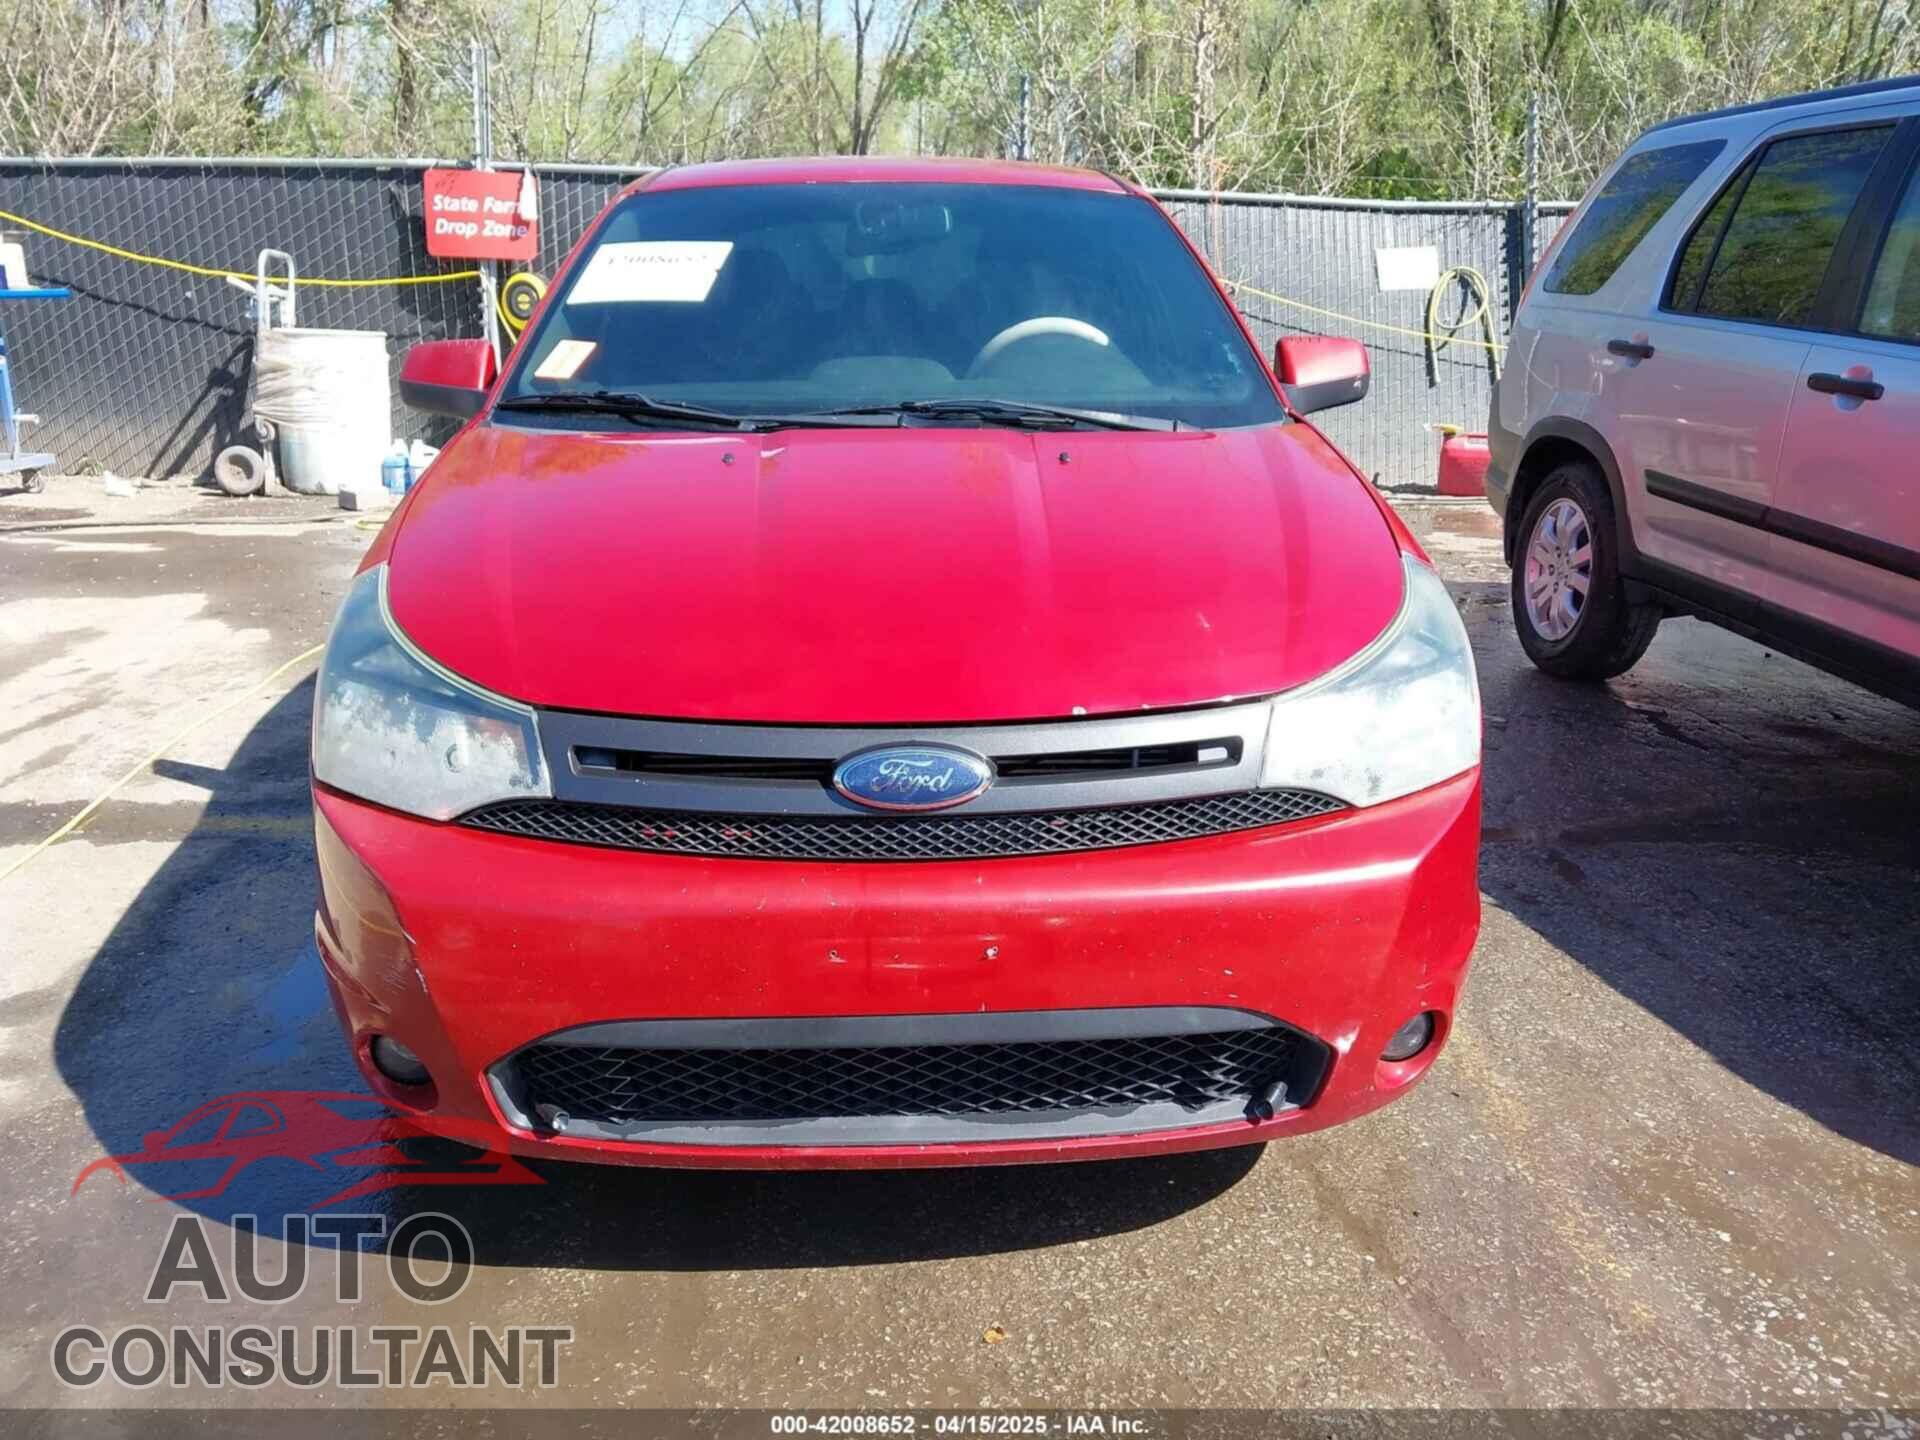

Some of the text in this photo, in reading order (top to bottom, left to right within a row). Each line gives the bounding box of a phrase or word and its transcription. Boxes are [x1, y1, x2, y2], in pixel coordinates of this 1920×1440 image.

[432, 194, 479, 213] State
[435, 218, 528, 239] Drop Zone
[872, 759, 953, 792] Ford
